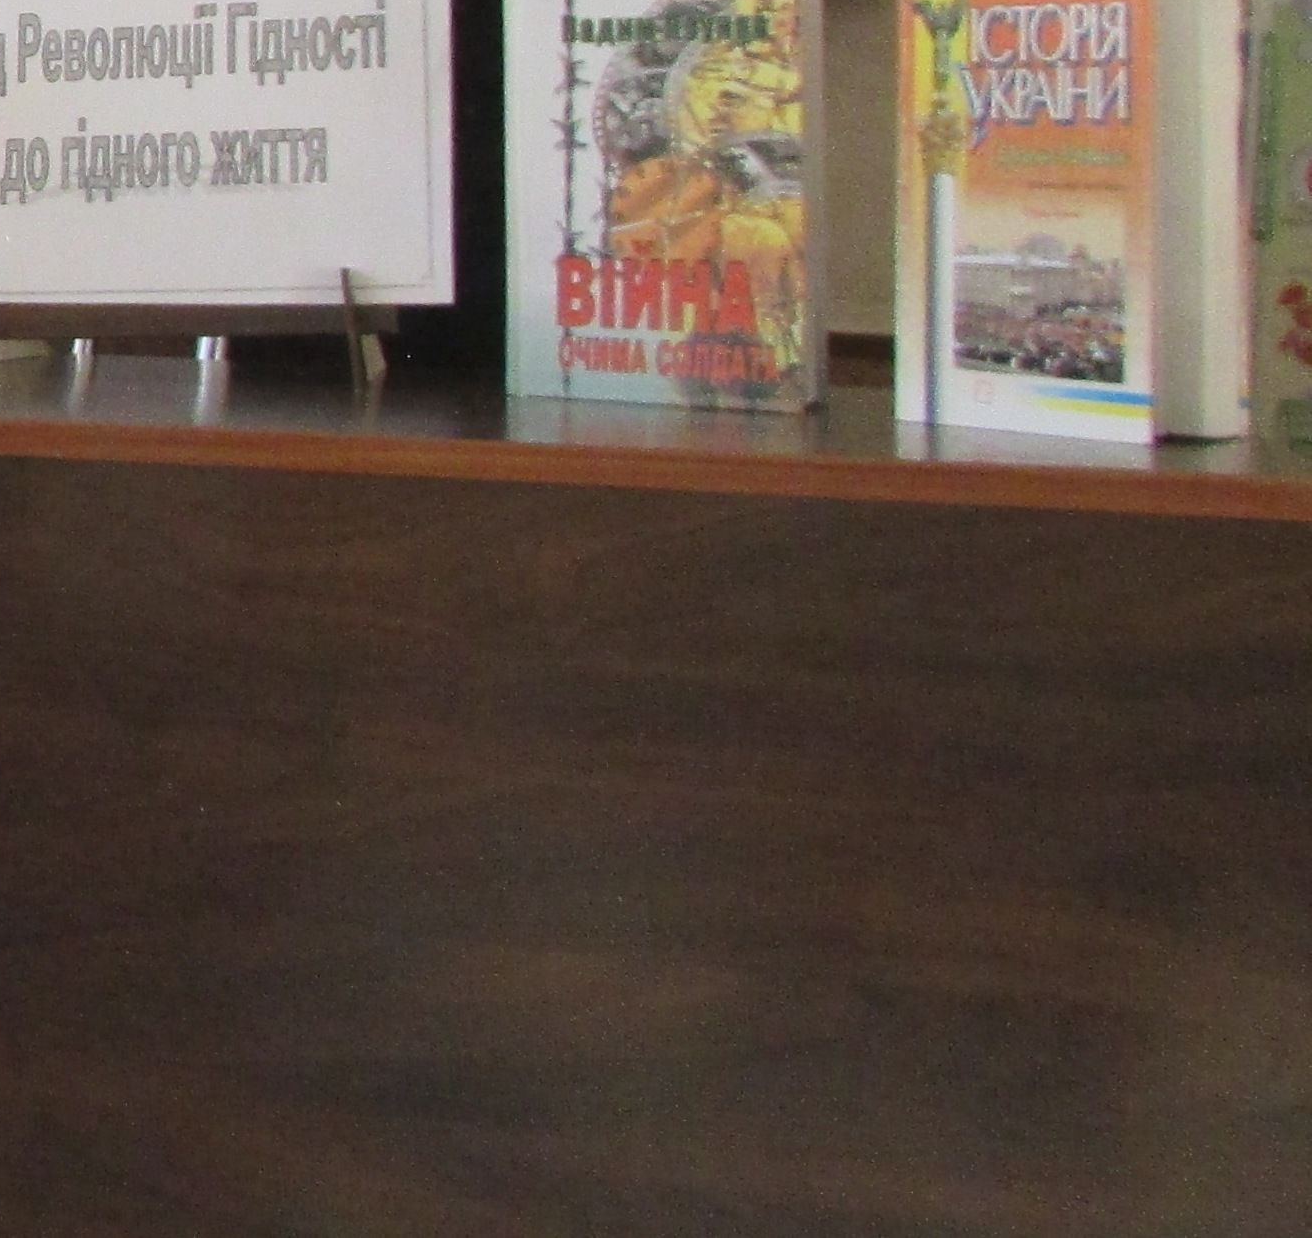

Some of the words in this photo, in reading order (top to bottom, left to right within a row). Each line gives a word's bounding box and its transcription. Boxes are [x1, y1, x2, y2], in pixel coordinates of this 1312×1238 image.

[17, 2, 217, 89] Революції
[970, 1, 1127, 62] ІСТОРІЯ
[0, 136, 50, 205] до
[61, 116, 200, 202] гідного
[210, 127, 328, 187] життя
[556, 240, 759, 335] ВІЙНА
